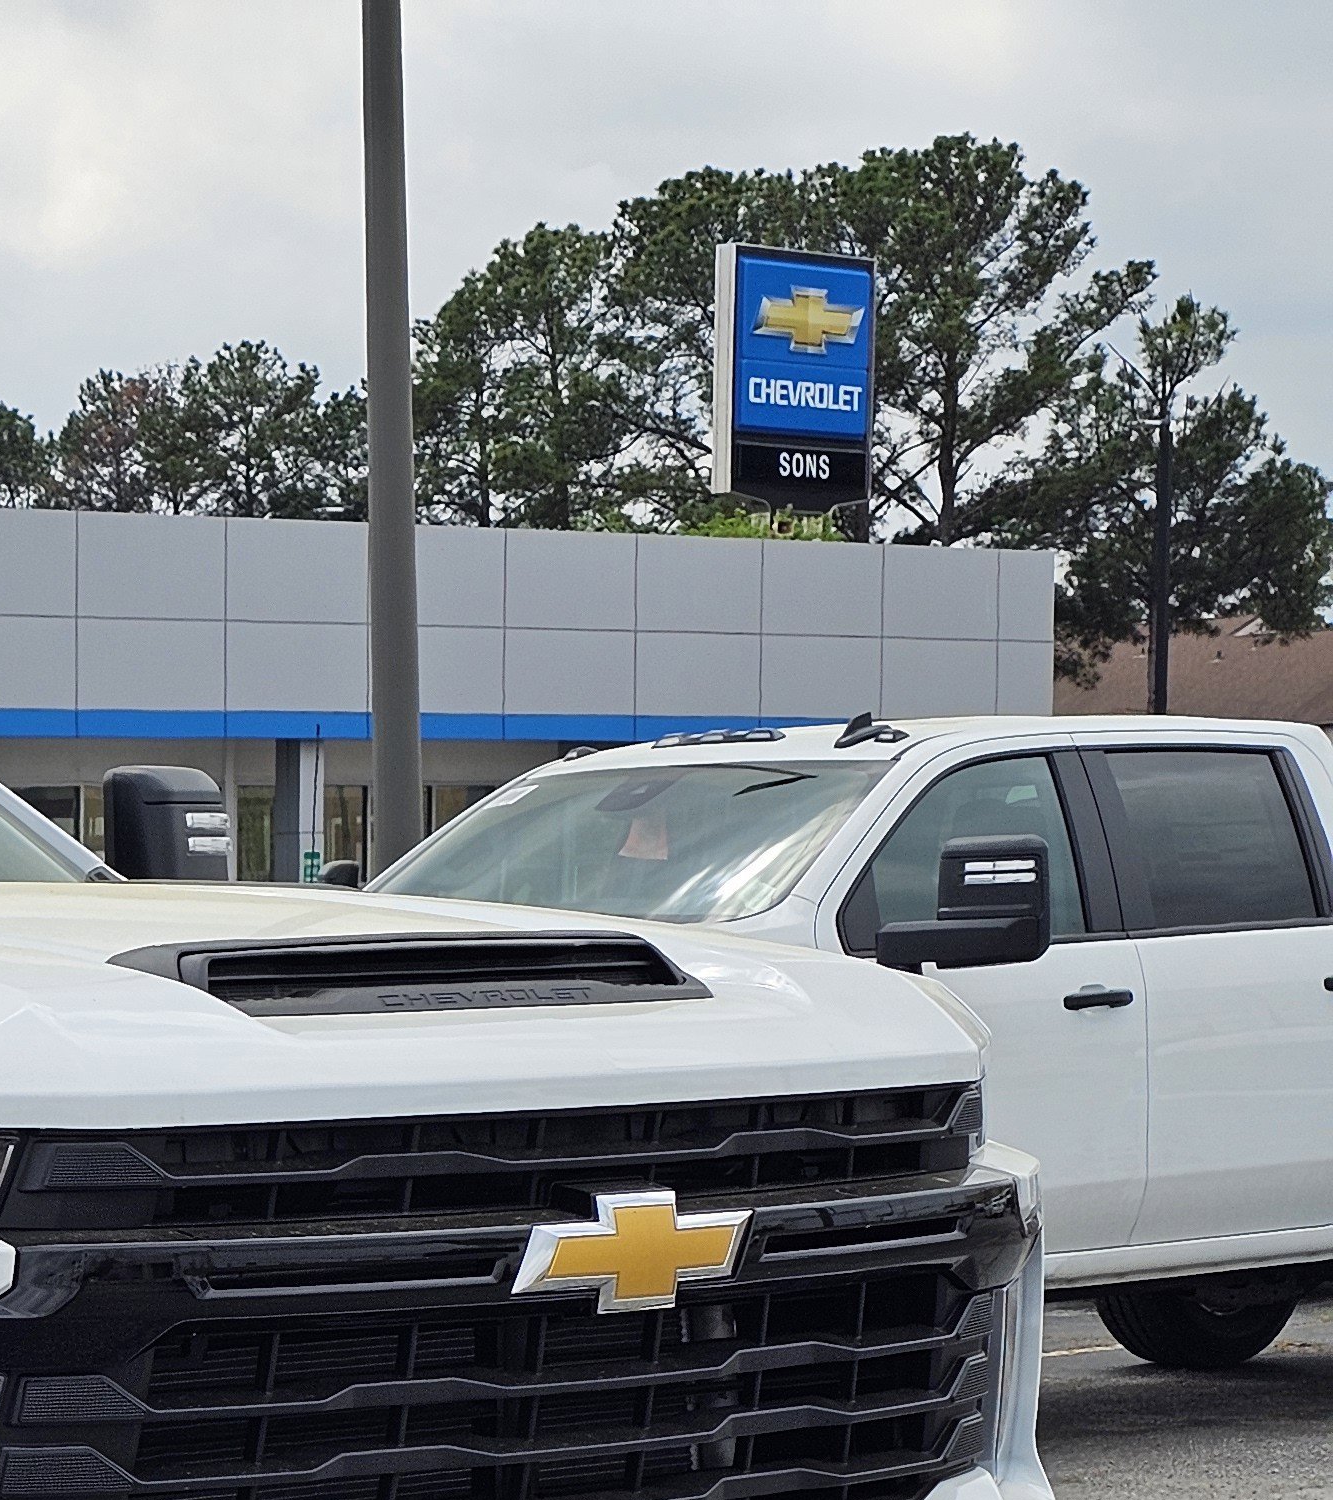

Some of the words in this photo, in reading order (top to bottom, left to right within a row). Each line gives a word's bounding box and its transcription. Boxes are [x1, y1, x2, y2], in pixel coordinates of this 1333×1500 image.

[748, 376, 863, 412] CHEVROLET
[778, 451, 830, 480] SONS
[377, 986, 592, 1007] CHEVROLET
